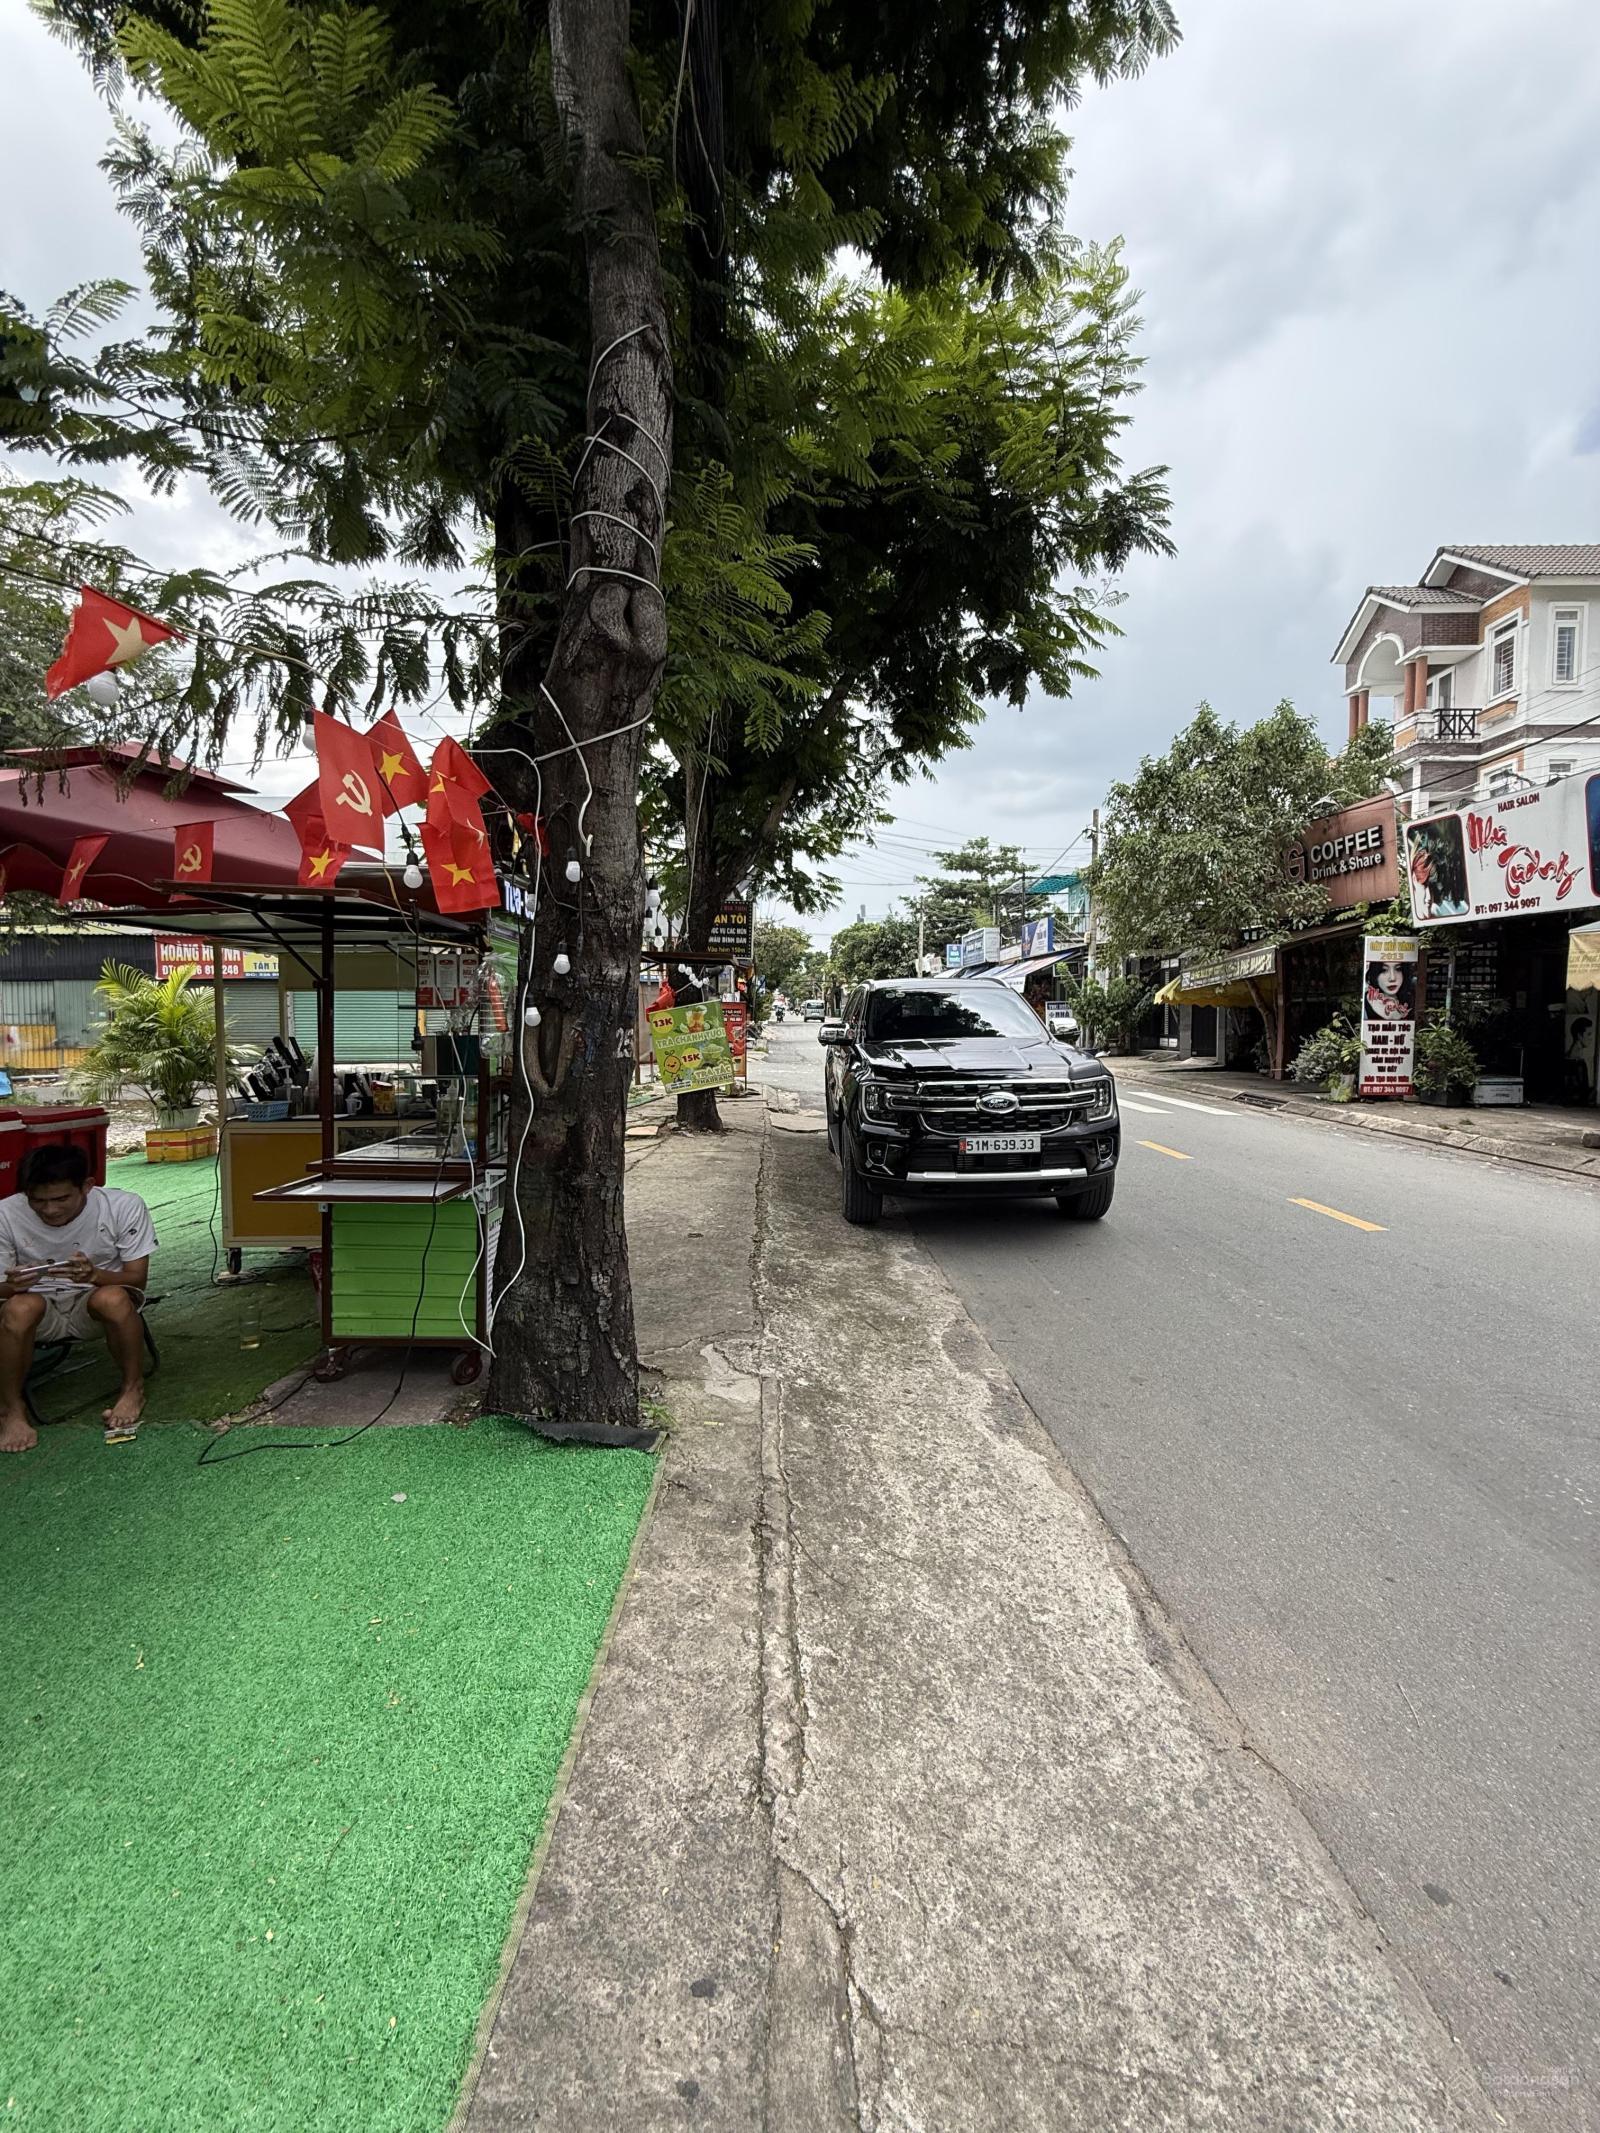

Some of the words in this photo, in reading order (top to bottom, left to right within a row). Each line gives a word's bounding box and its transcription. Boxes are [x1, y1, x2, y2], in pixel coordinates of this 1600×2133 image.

[1498, 801, 1515, 813] HAIR
[1516, 793, 1540, 808] SALON
[1310, 826, 1382, 863] COFFEE
[1312, 862, 1338, 880] Drink
[1339, 860, 1348, 873] &
[1349, 853, 1382, 871] Share
[1488, 902, 1502, 913] 097
[1504, 900, 1519, 911] 344
[1521, 897, 1541, 909] 9097
[160, 941, 199, 962] HOÀNG
[222, 966, 239, 974] 248
[653, 1018, 673, 1027] 13K
[656, 1037, 674, 1049] TRÀ
[675, 1032, 706, 1045] CHANH
[681, 1053, 701, 1063] 15K
[694, 1066, 713, 1079] TRÀ
[988, 1098, 1009, 1108] Ford
